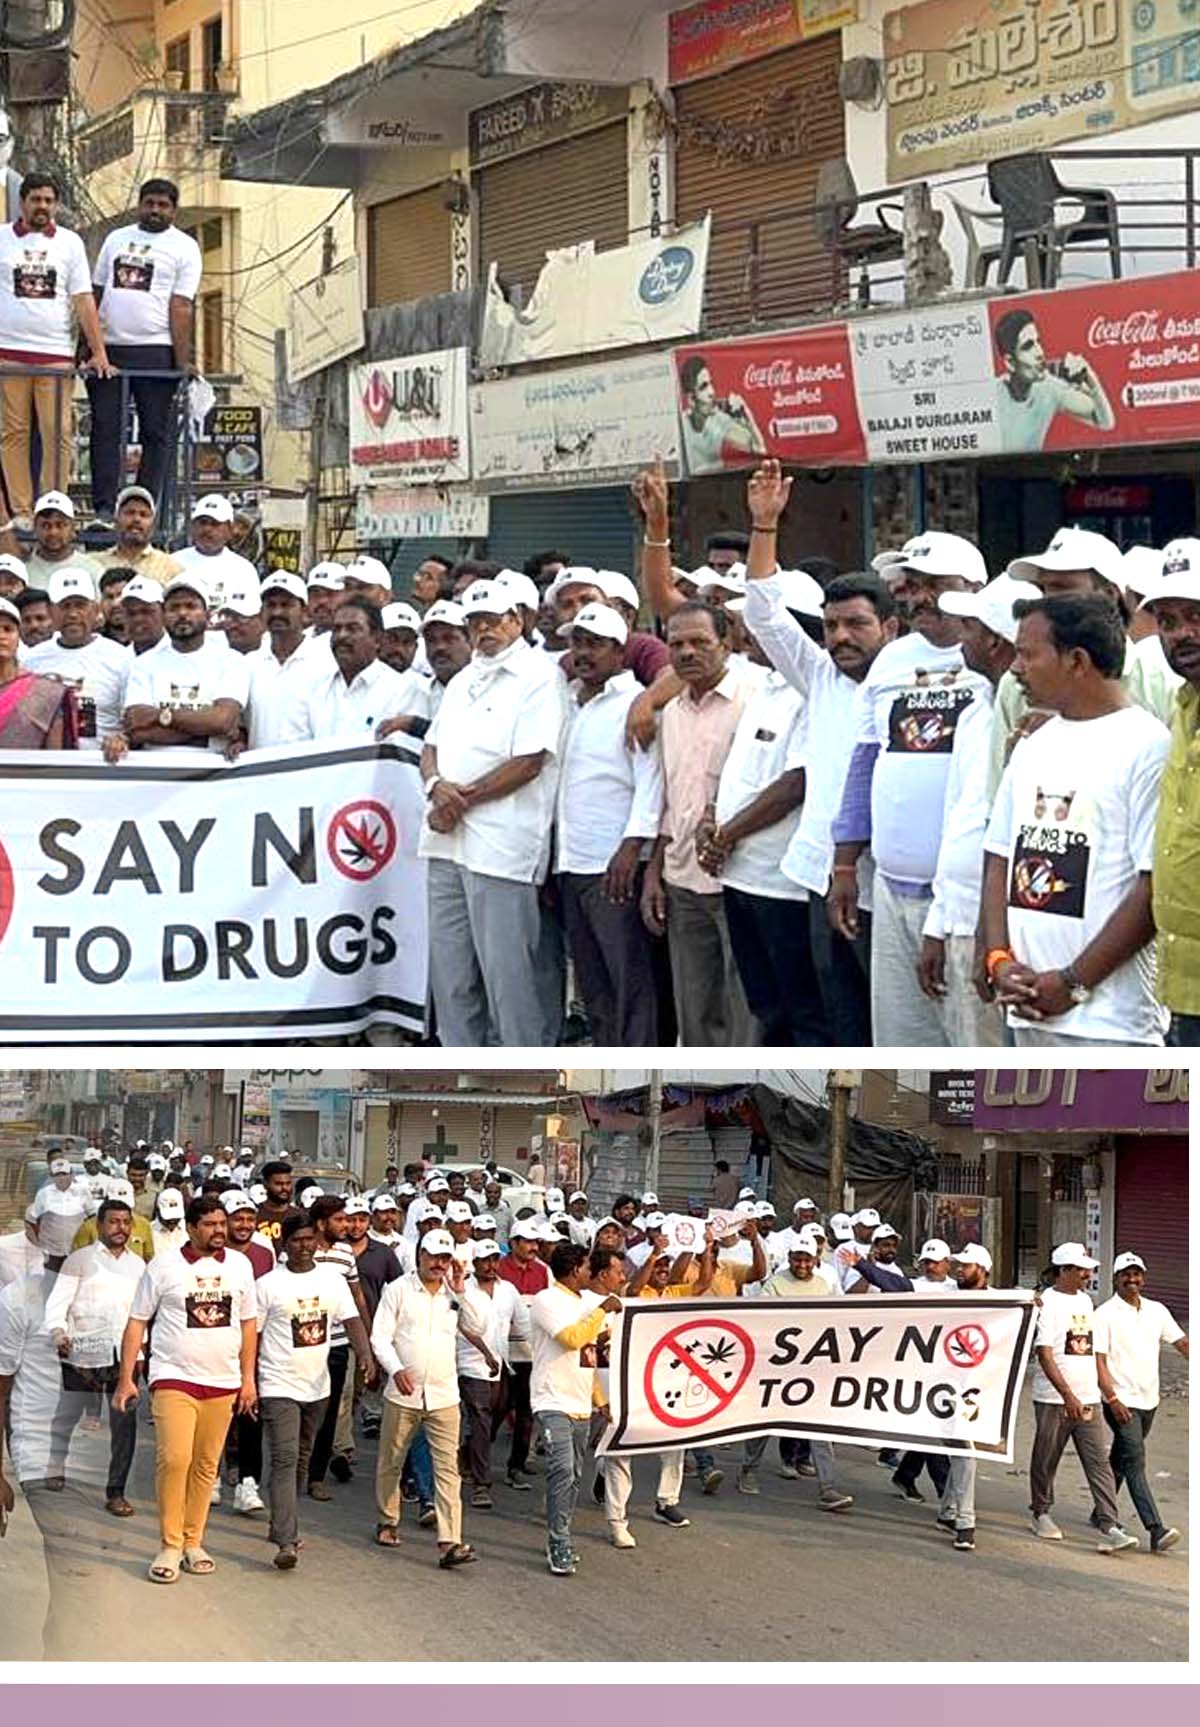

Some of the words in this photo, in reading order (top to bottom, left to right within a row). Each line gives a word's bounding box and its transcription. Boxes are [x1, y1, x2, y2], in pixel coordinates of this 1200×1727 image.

[648, 155, 661, 239] NOTAR
[913, 393, 937, 405] SRI
[216, 410, 254, 421] FOOD
[867, 413, 913, 432] BALAJI
[916, 409, 994, 429] DURGARAM
[886, 437, 929, 455] SWEET
[932, 433, 979, 451] HOUSE
[1040, 827, 1060, 841] NO
[1064, 829, 1088, 846] TO
[36, 817, 217, 896] SAY
[32, 925, 132, 985] TO
[161, 905, 398, 983] DRUGS
[768, 1326, 884, 1366] SAY
[759, 1378, 815, 1407] TO
[830, 1376, 981, 1421] DRUGS
